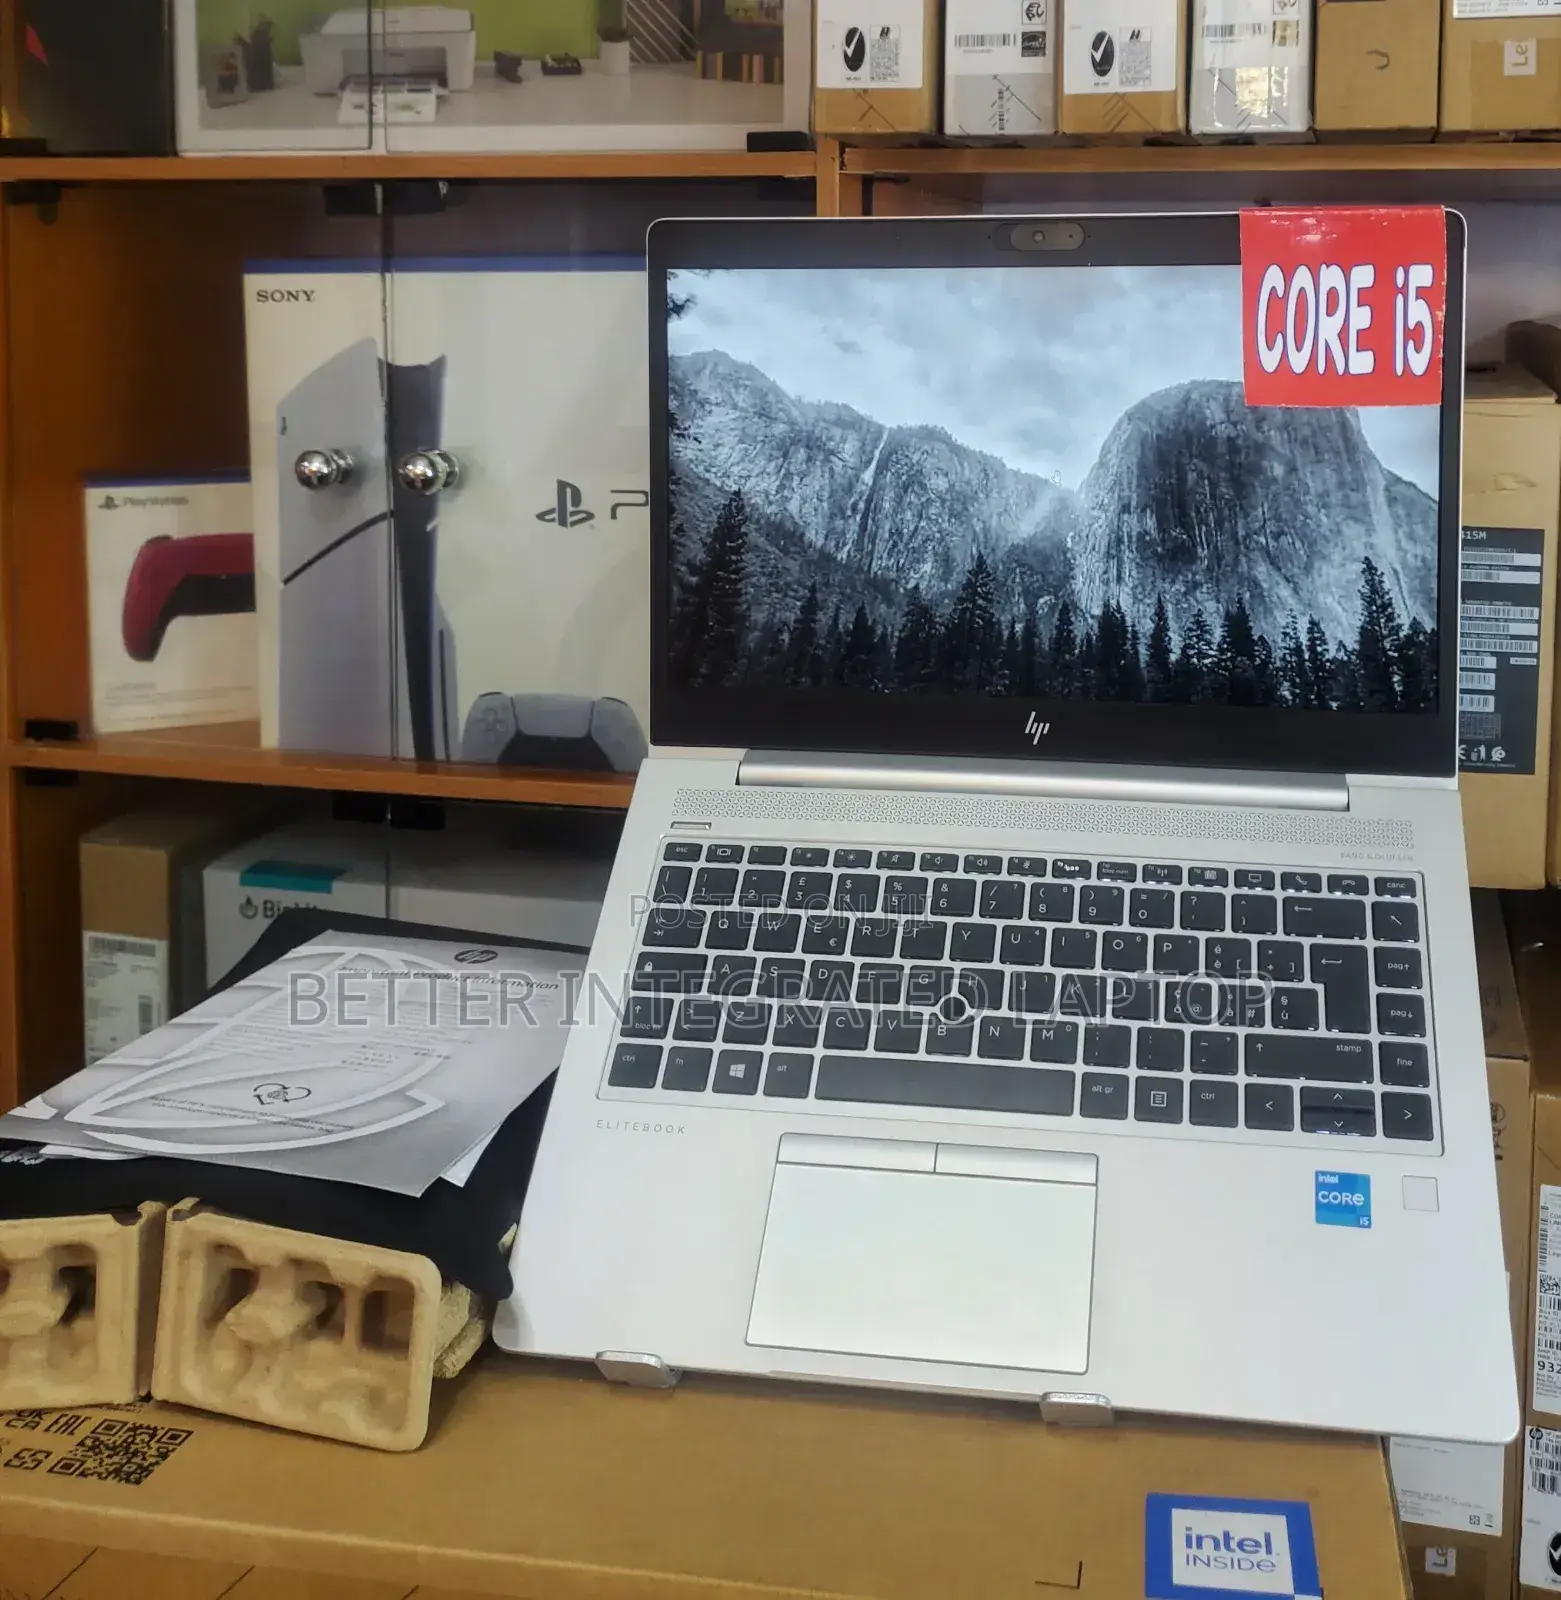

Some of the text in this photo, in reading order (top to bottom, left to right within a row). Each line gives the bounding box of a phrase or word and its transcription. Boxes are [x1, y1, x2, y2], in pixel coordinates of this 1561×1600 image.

[255, 288, 316, 303] SONY
[1257, 263, 1434, 377] CORE i5
[1025, 711, 1050, 745] hp
[798, 877, 806, 885] £
[845, 879, 852, 889] $
[893, 882, 902, 891] %
[1386, 881, 1406, 889] canc
[941, 883, 949, 892] &
[747, 889, 755, 898] 2
[795, 891, 803, 901] 3
[891, 896, 899, 906] 5
[939, 898, 947, 908] 6
[989, 900, 997, 910] 7
[1038, 903, 1047, 913] 8
[1088, 906, 1097, 917] 9
[718, 918, 729, 929] Q
[766, 920, 781, 931] W
[813, 922, 822, 933] E
[862, 925, 872, 936] R
[912, 928, 919, 939] T
[961, 930, 971, 941] Y
[829, 937, 838, 947] €
[1011, 933, 1021, 944] U
[1113, 939, 1124, 950] O
[1163, 942, 1172, 953] P
[1214, 944, 1222, 955] é
[720, 963, 731, 974] A
[1214, 959, 1222, 969] è
[1387, 962, 1404, 971] pag
[769, 966, 778, 977] S
[818, 968, 828, 979] D
[867, 971, 877, 982] F
[919, 973, 929, 984] G
[968, 976, 978, 987] H
[1019, 979, 1027, 990] J
[1071, 983, 1081, 994] K
[1122, 986, 1130, 997] L
[1191, 1004, 1202, 1014] @
[1247, 1008, 1256, 1018] #
[1390, 1008, 1407, 1018] pag
[735, 1011, 745, 1022] Z
[784, 1014, 795, 1025] X
[836, 1017, 846, 1028] C
[887, 1019, 898, 1031] V
[937, 1025, 947, 1036] B
[990, 1026, 1000, 1037] N
[1042, 1029, 1054, 1040] M
[1336, 1043, 1362, 1054] stamp
[621, 1054, 636, 1063] ctrl
[675, 1057, 684, 1066] fn
[1396, 1057, 1413, 1067] fine
[776, 1064, 788, 1073] alt
[1092, 1084, 1114, 1095] alt gr
[1201, 1091, 1216, 1101] ctrl
[596, 1119, 685, 1135] ELITEBOOK
[1318, 1173, 1339, 1184] intel
[1359, 1216, 1369, 1226] i5
[1184, 1526, 1273, 1556] intel
